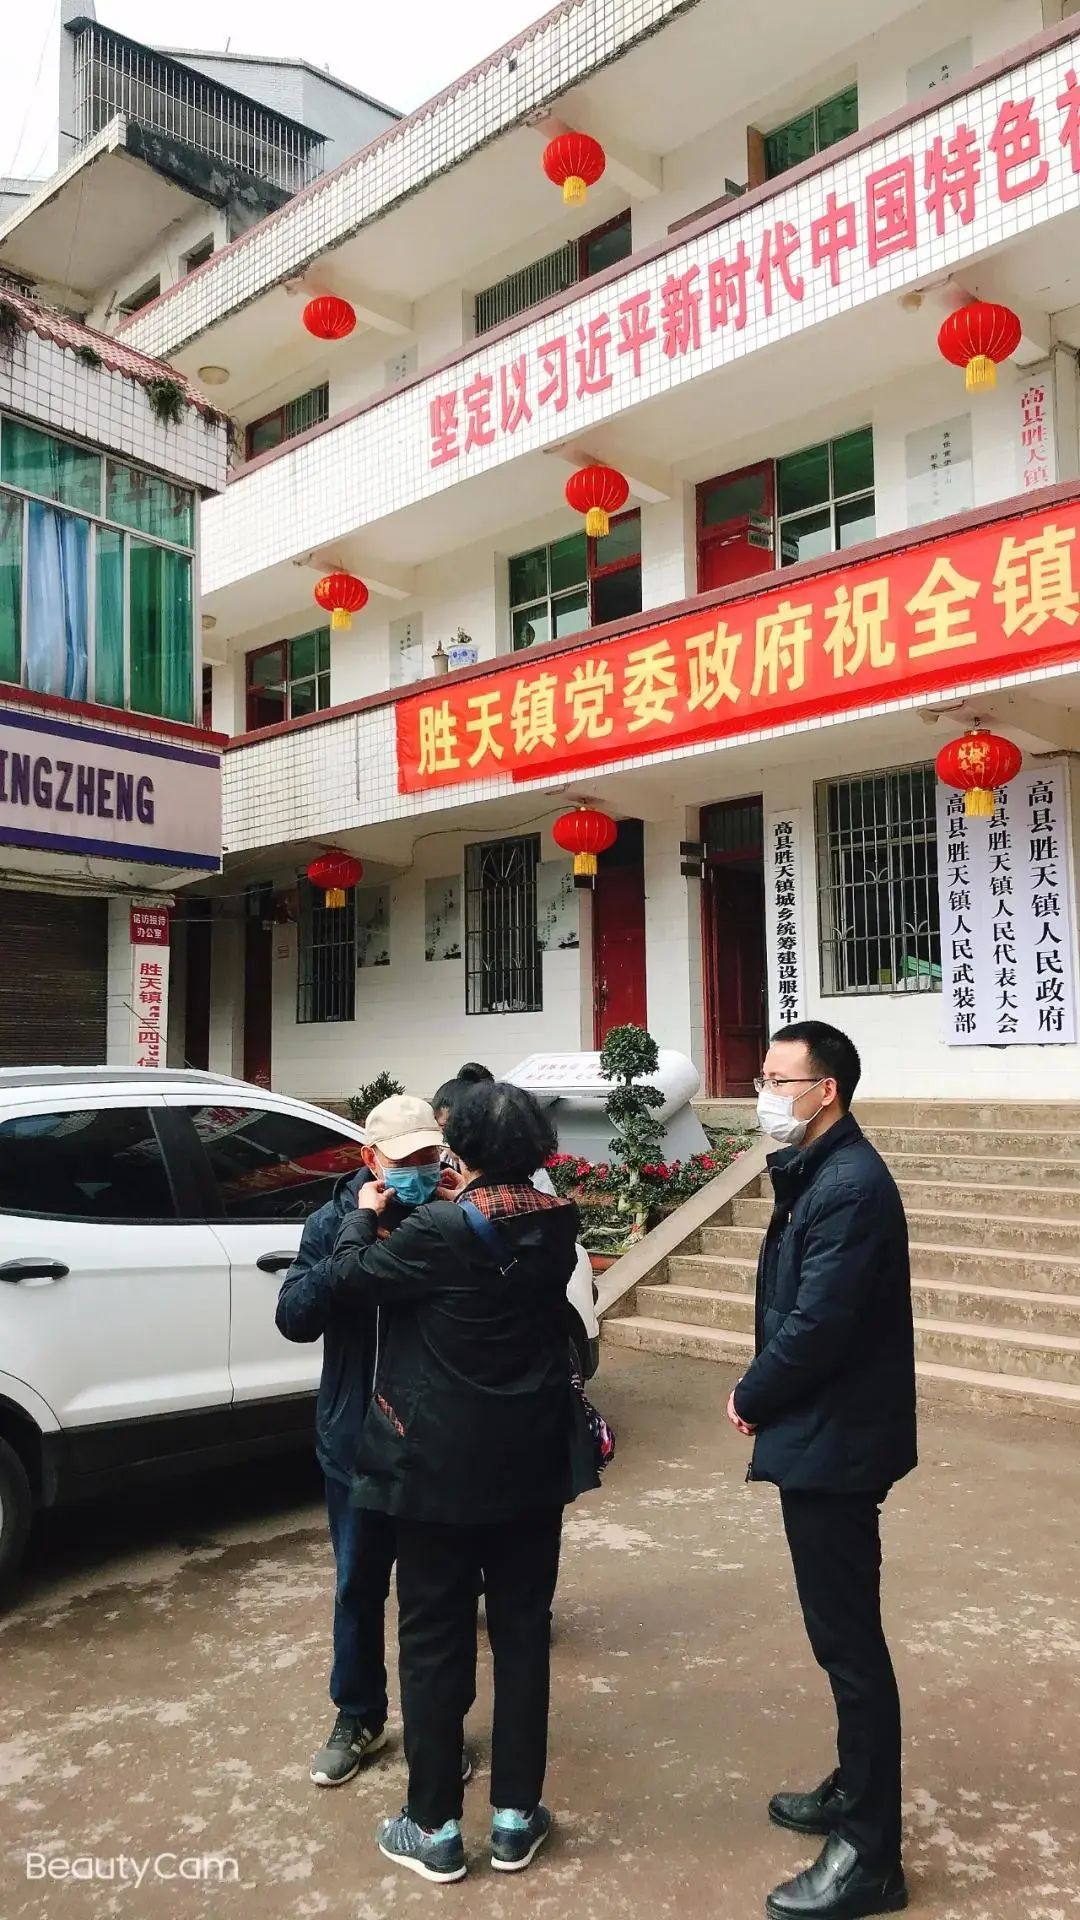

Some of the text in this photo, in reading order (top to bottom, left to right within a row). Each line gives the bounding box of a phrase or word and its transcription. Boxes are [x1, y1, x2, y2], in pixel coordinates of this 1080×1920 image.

[1020, 384, 1049, 491] 高县胜天镇
[417, 524, 1080, 776] 胜天镇党委政府祝全镇
[133, 913, 167, 926] 信访接待
[137, 927, 162, 939] 办公室
[773, 820, 799, 1024] 高县胜天镇城乡统筹建设服务中
[945, 793, 977, 1034] 高县胜天镇人民武装部
[986, 785, 1019, 1034] 高县胜天镇人民代表大会
[1026, 780, 1066, 1032] 高县胜天镇人民政府
